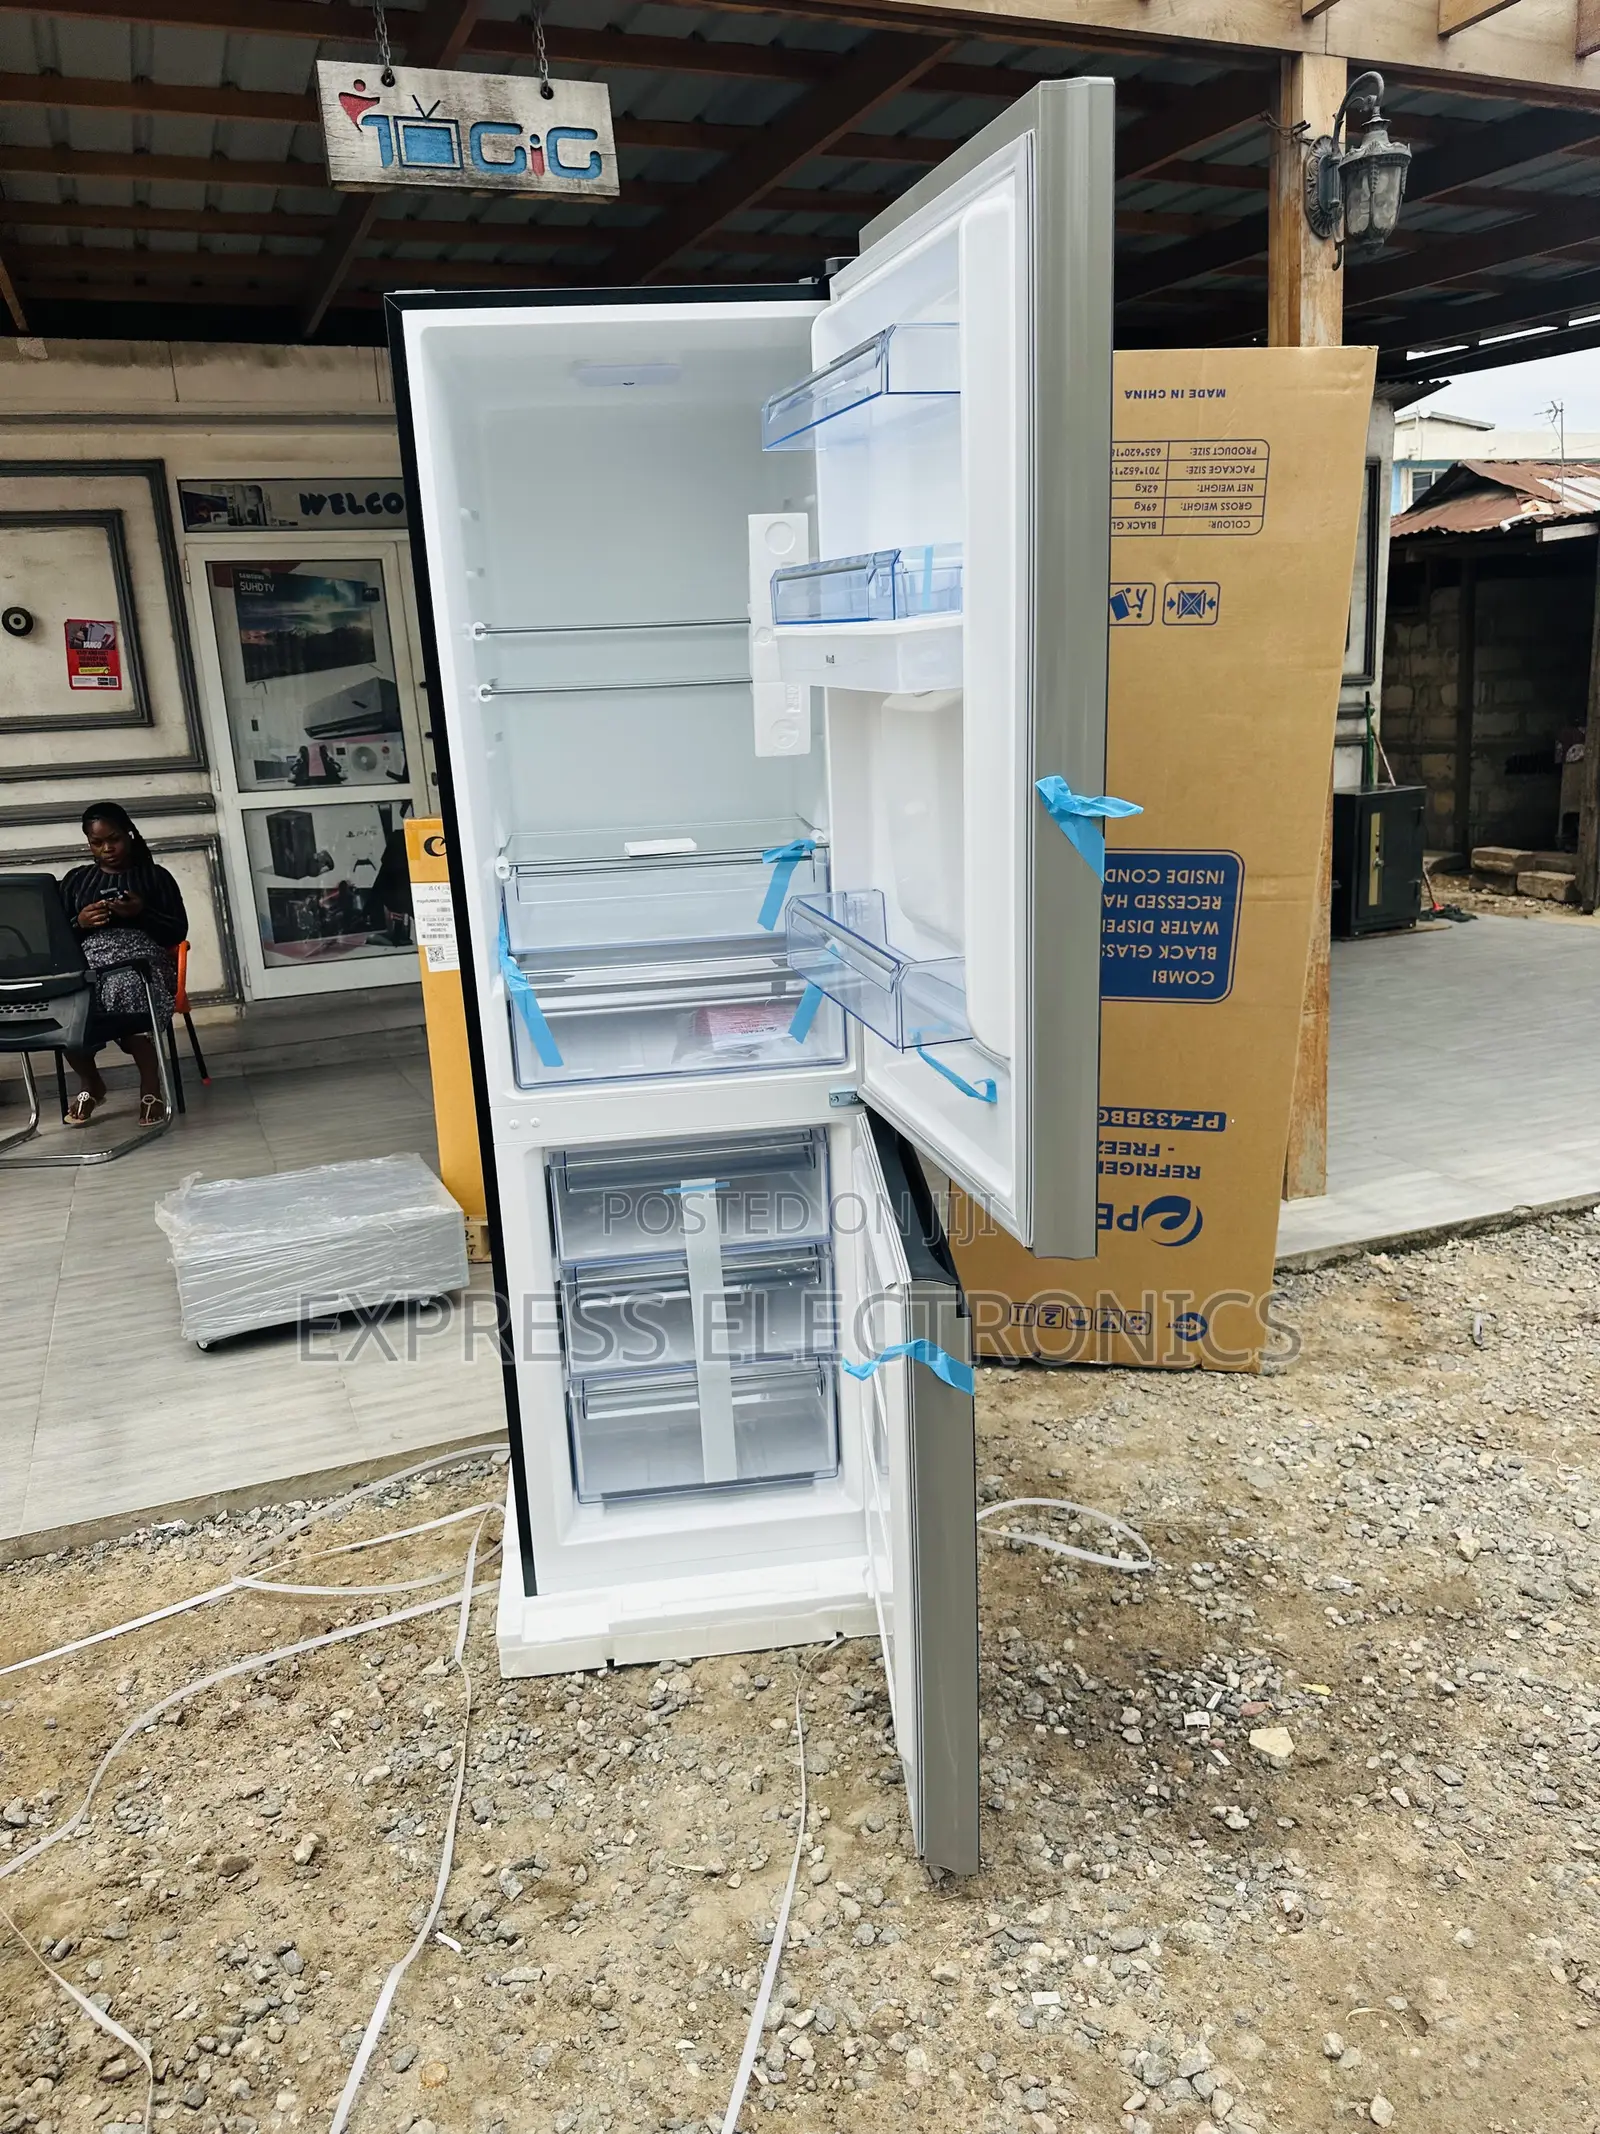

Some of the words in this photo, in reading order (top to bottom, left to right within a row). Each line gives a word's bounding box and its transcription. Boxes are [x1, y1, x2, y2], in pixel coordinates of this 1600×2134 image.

[1124, 389, 1167, 399] CHINA
[1170, 389, 1185, 399] IN
[1188, 388, 1226, 399] MADE
[1190, 447, 1211, 457] SIZE:
[1212, 446, 1257, 456] PRODUCT
[1185, 466, 1207, 475] SIZE:
[1208, 465, 1256, 475] PACKAGE
[1135, 483, 1159, 493] 62Kg
[1197, 484, 1235, 493] WEIGHT:
[1236, 483, 1254, 493] NET
[298, 491, 405, 516] WELCO
[1134, 501, 1157, 511] 69Kg
[1180, 502, 1218, 511] WEIGHT:
[1220, 502, 1252, 511] GROSS
[1127, 521, 1157, 530] BLACK
[1208, 520, 1251, 529] COLOUR:
[1104, 868, 1161, 884] COND
[1166, 869, 1225, 885] INSIDE
[1103, 894, 1128, 909] HA
[1134, 895, 1222, 910] RECESSED
[1102, 919, 1154, 934] DISPE
[1160, 920, 1219, 935] WATER
[1158, 946, 1217, 961] BLACK
[1152, 970, 1215, 985] COMBI
[1165, 1321, 1197, 1331] FRONT
